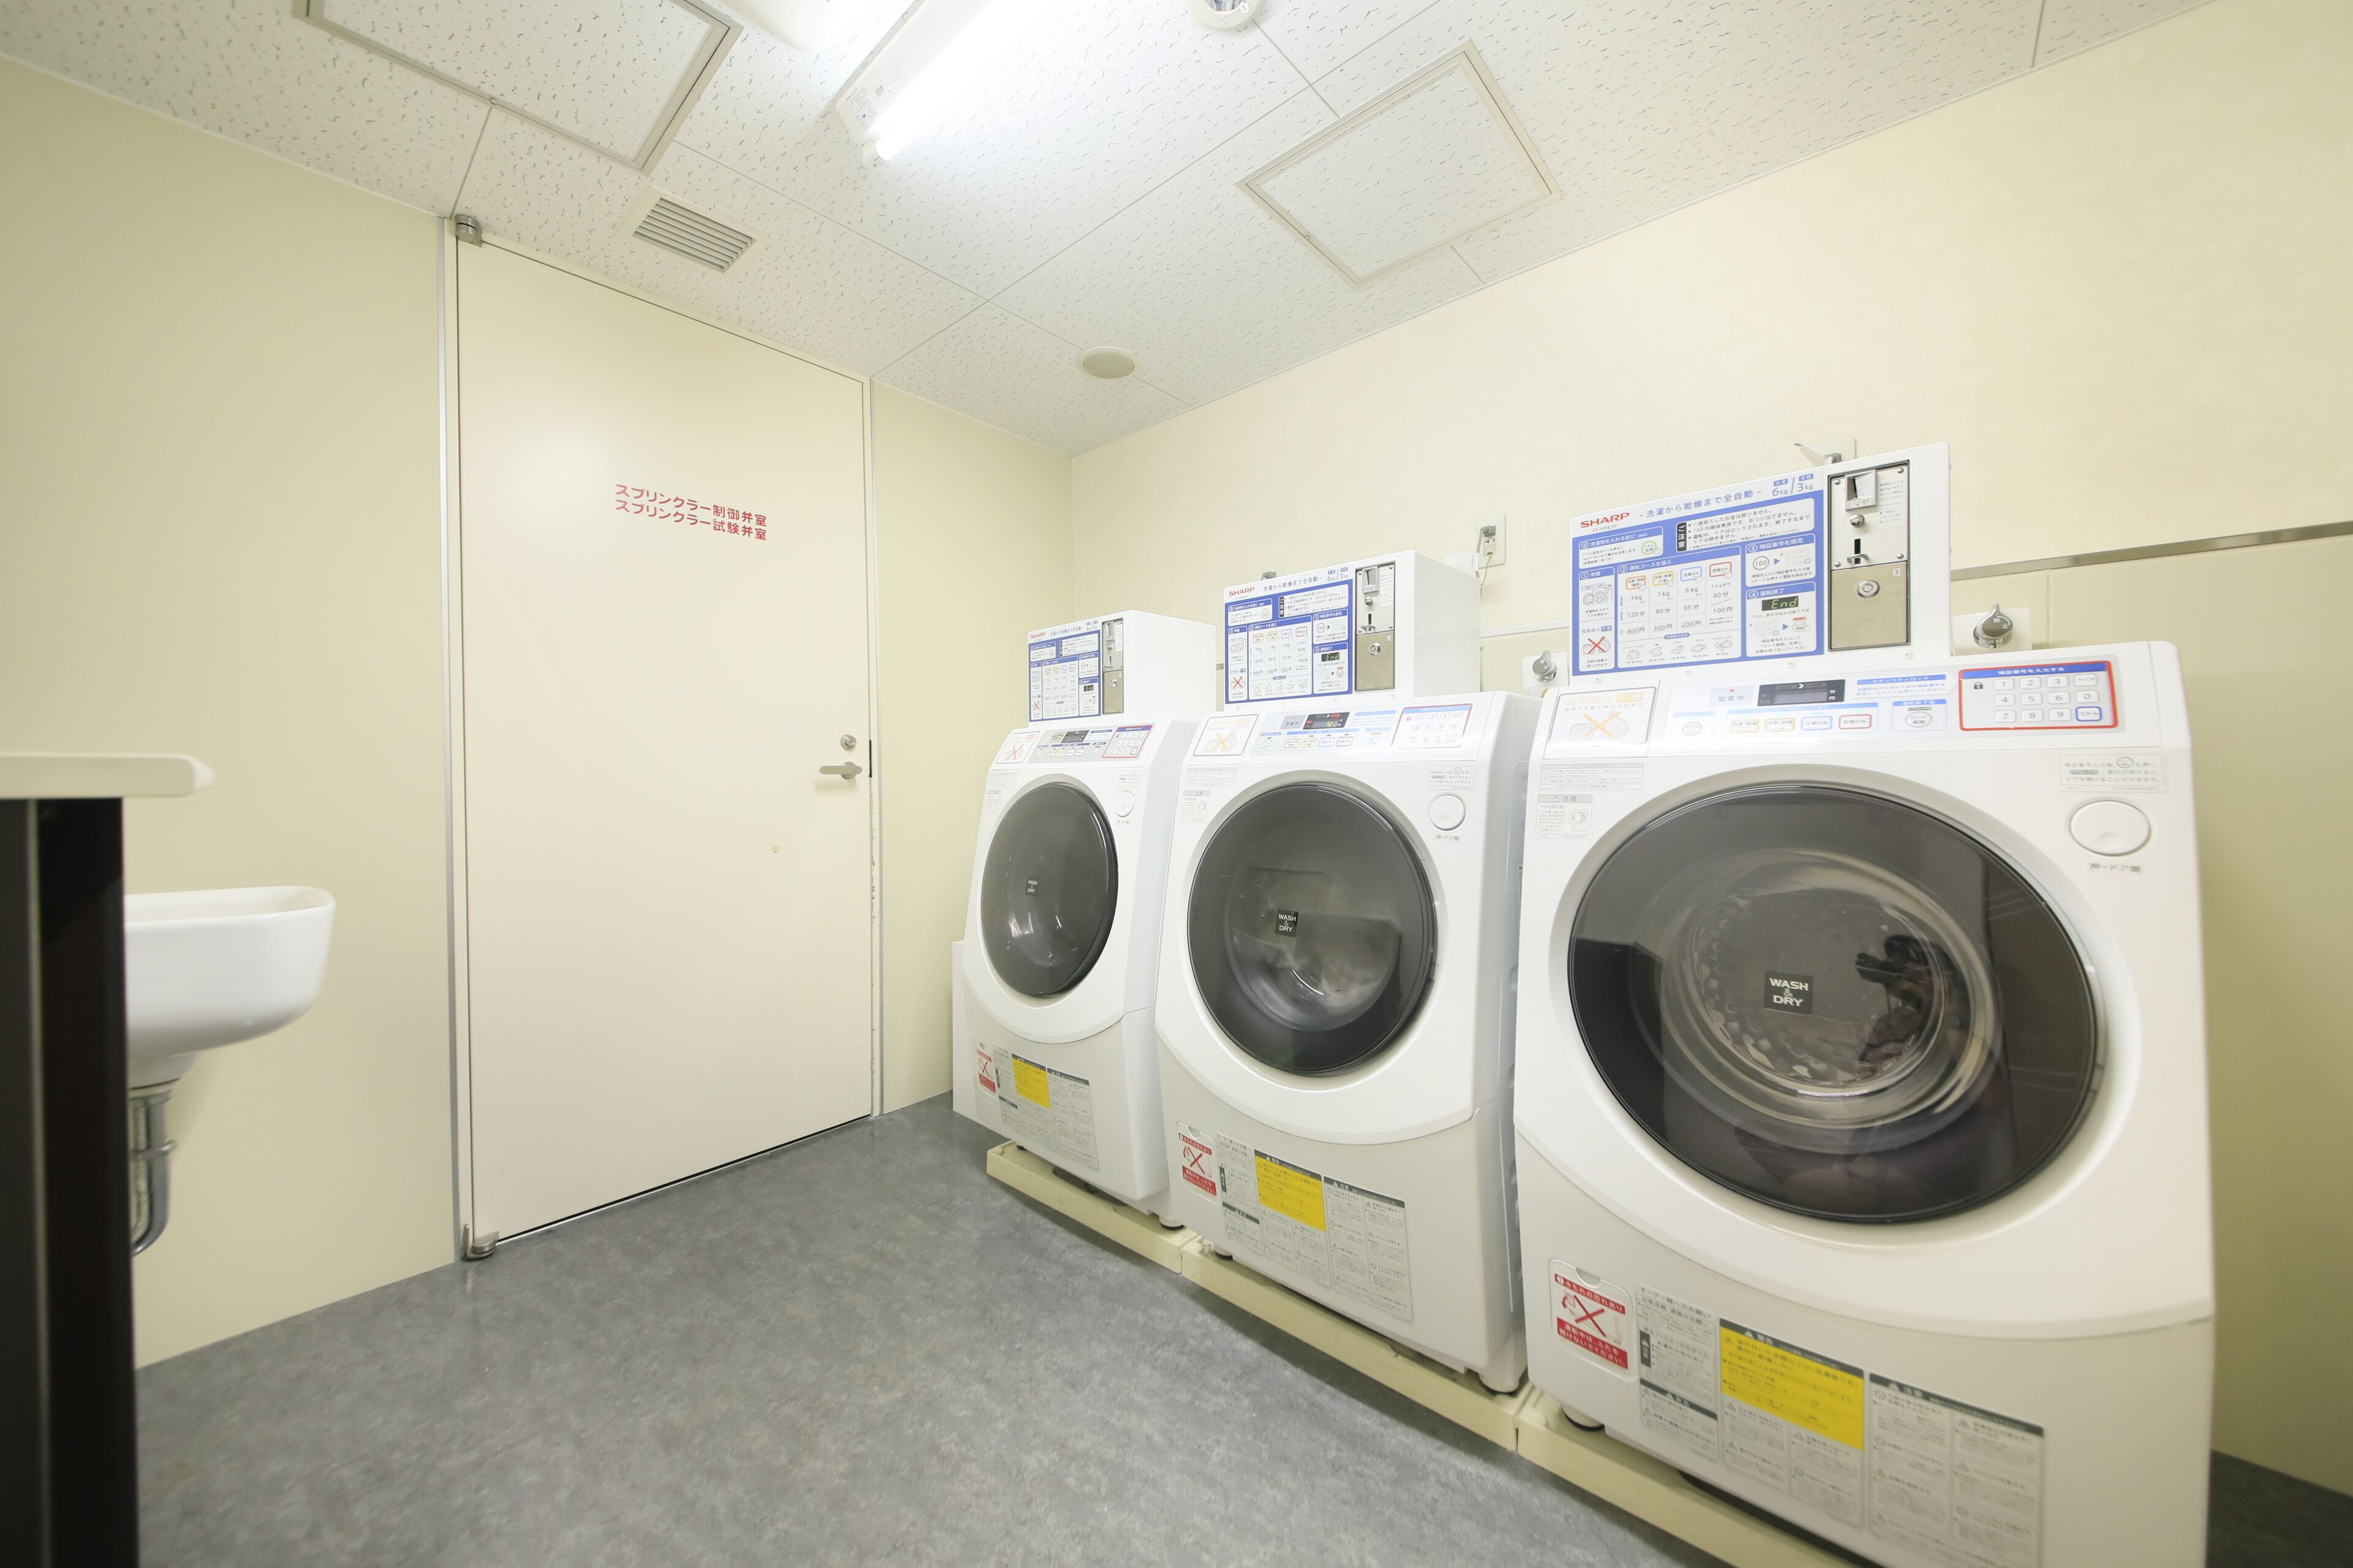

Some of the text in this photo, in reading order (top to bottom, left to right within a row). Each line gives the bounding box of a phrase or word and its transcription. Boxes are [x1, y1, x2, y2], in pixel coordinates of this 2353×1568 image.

[615, 483, 767, 528] スプリンクラー制御弁室
[615, 499, 767, 541] スプリンクラー試験弁室
[1580, 512, 1630, 528] SHARP
[1229, 586, 1255, 597] SHARP
[1771, 597, 1798, 610] End
[1653, 623, 1673, 632] 300円
[1769, 977, 1808, 991] WASH
[1784, 988, 1794, 998] &
[1773, 995, 1803, 1007] DRY
